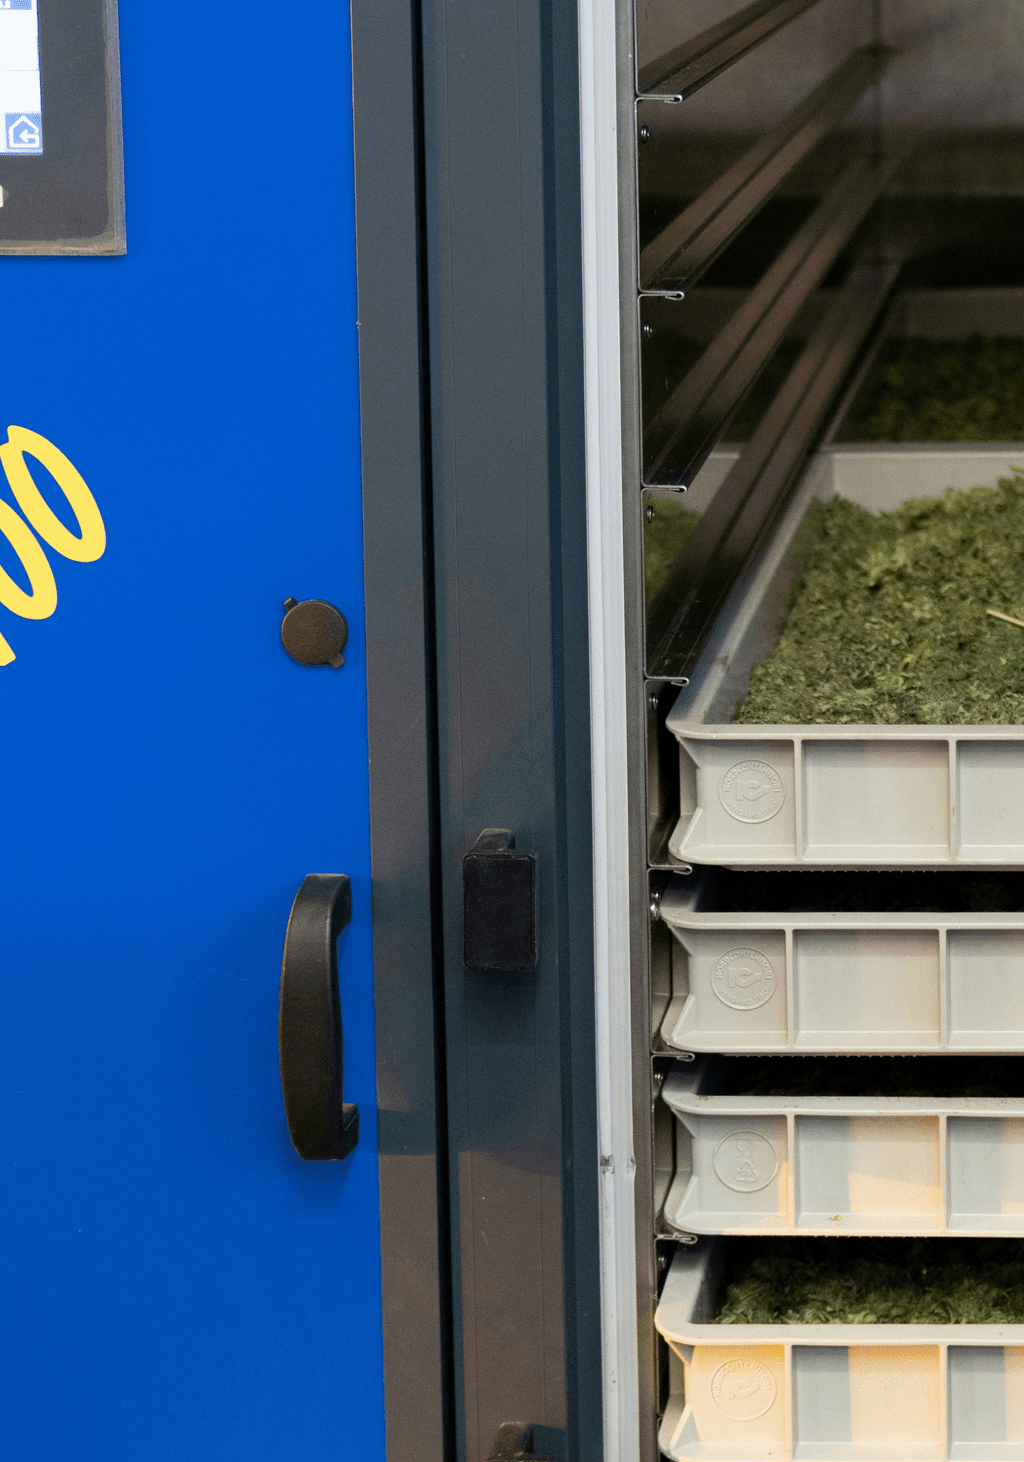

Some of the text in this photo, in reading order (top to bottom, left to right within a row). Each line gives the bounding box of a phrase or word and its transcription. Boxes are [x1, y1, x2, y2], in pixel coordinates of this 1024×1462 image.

[723, 761, 781, 793] NORDCONTENITORI
[726, 799, 778, 819] BERGAMO ITALY
[714, 949, 773, 980] NORDCONTENITORI
[719, 987, 769, 1006] BERGAMO ITALY
